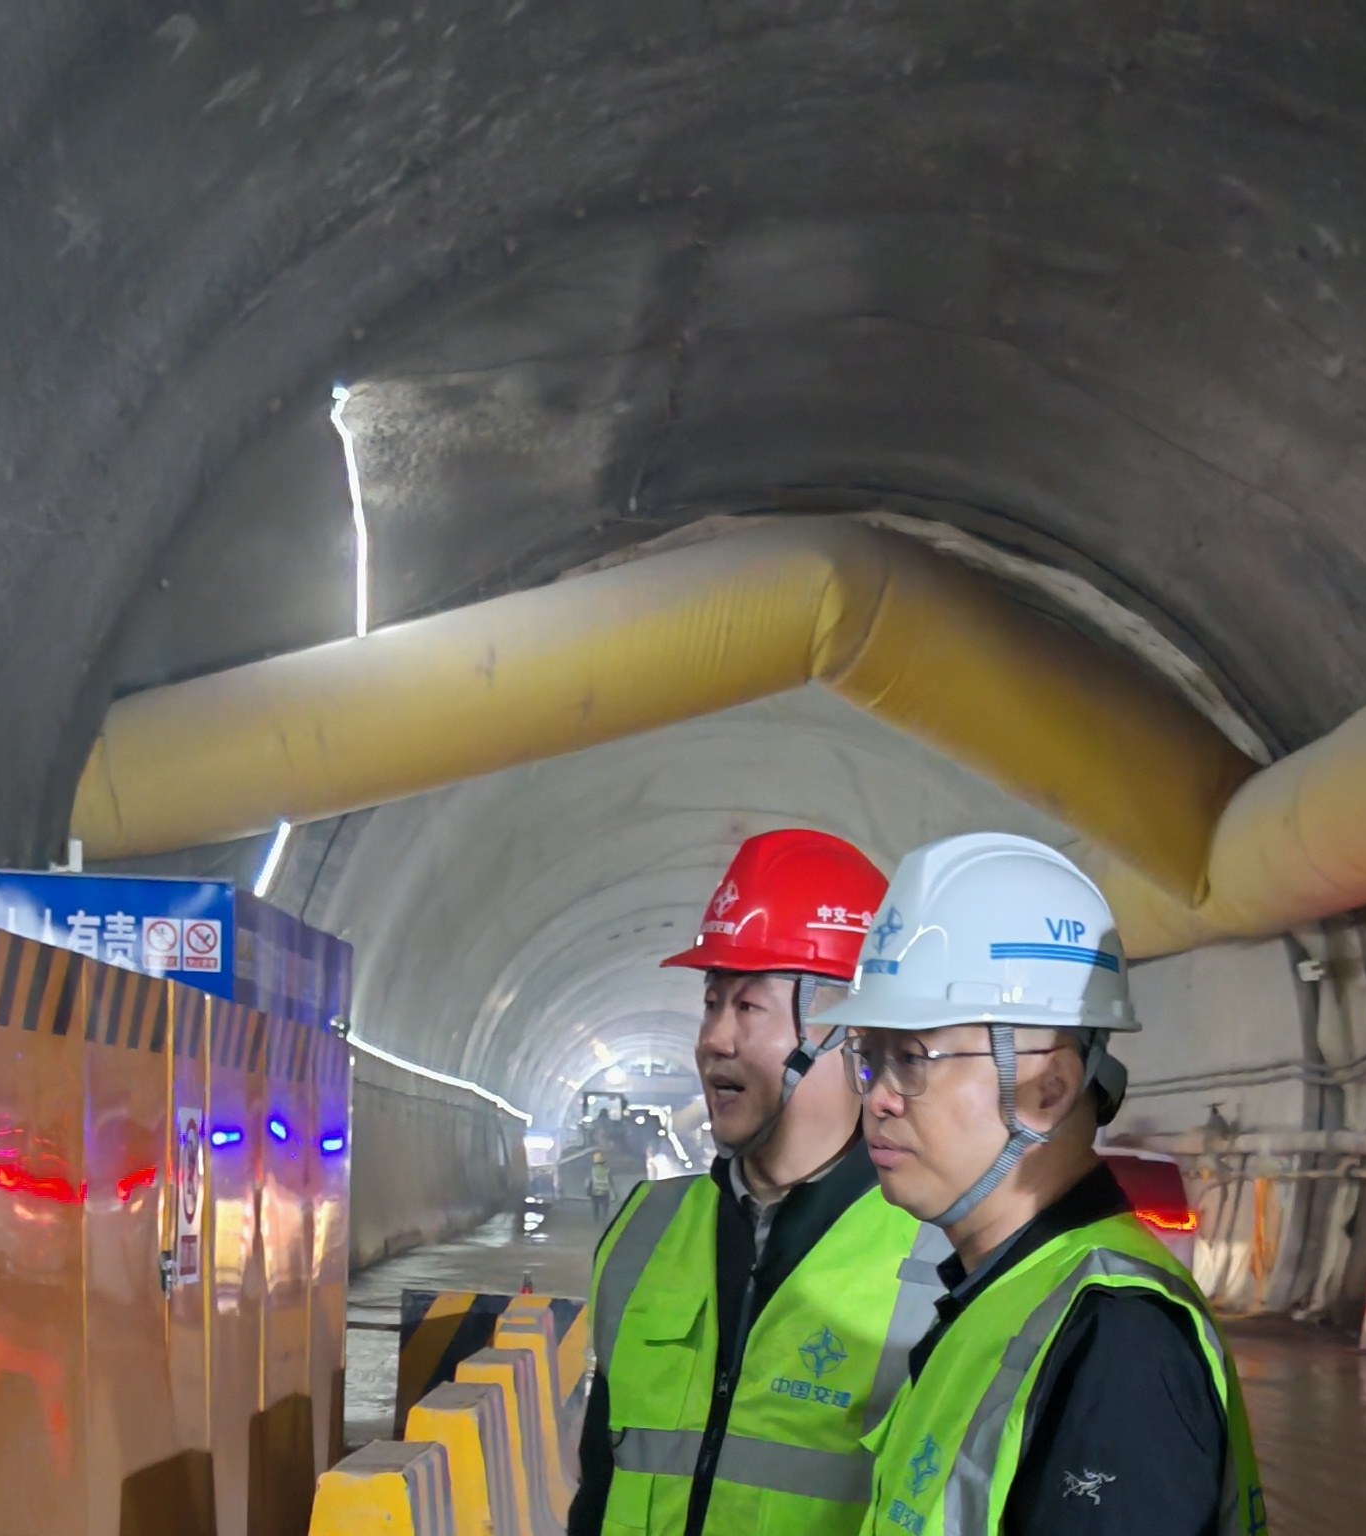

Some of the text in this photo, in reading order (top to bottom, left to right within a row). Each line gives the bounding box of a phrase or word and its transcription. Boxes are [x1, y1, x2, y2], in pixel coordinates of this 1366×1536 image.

[817, 904, 875, 927] 中交一公
[1045, 917, 1086, 943] VIP
